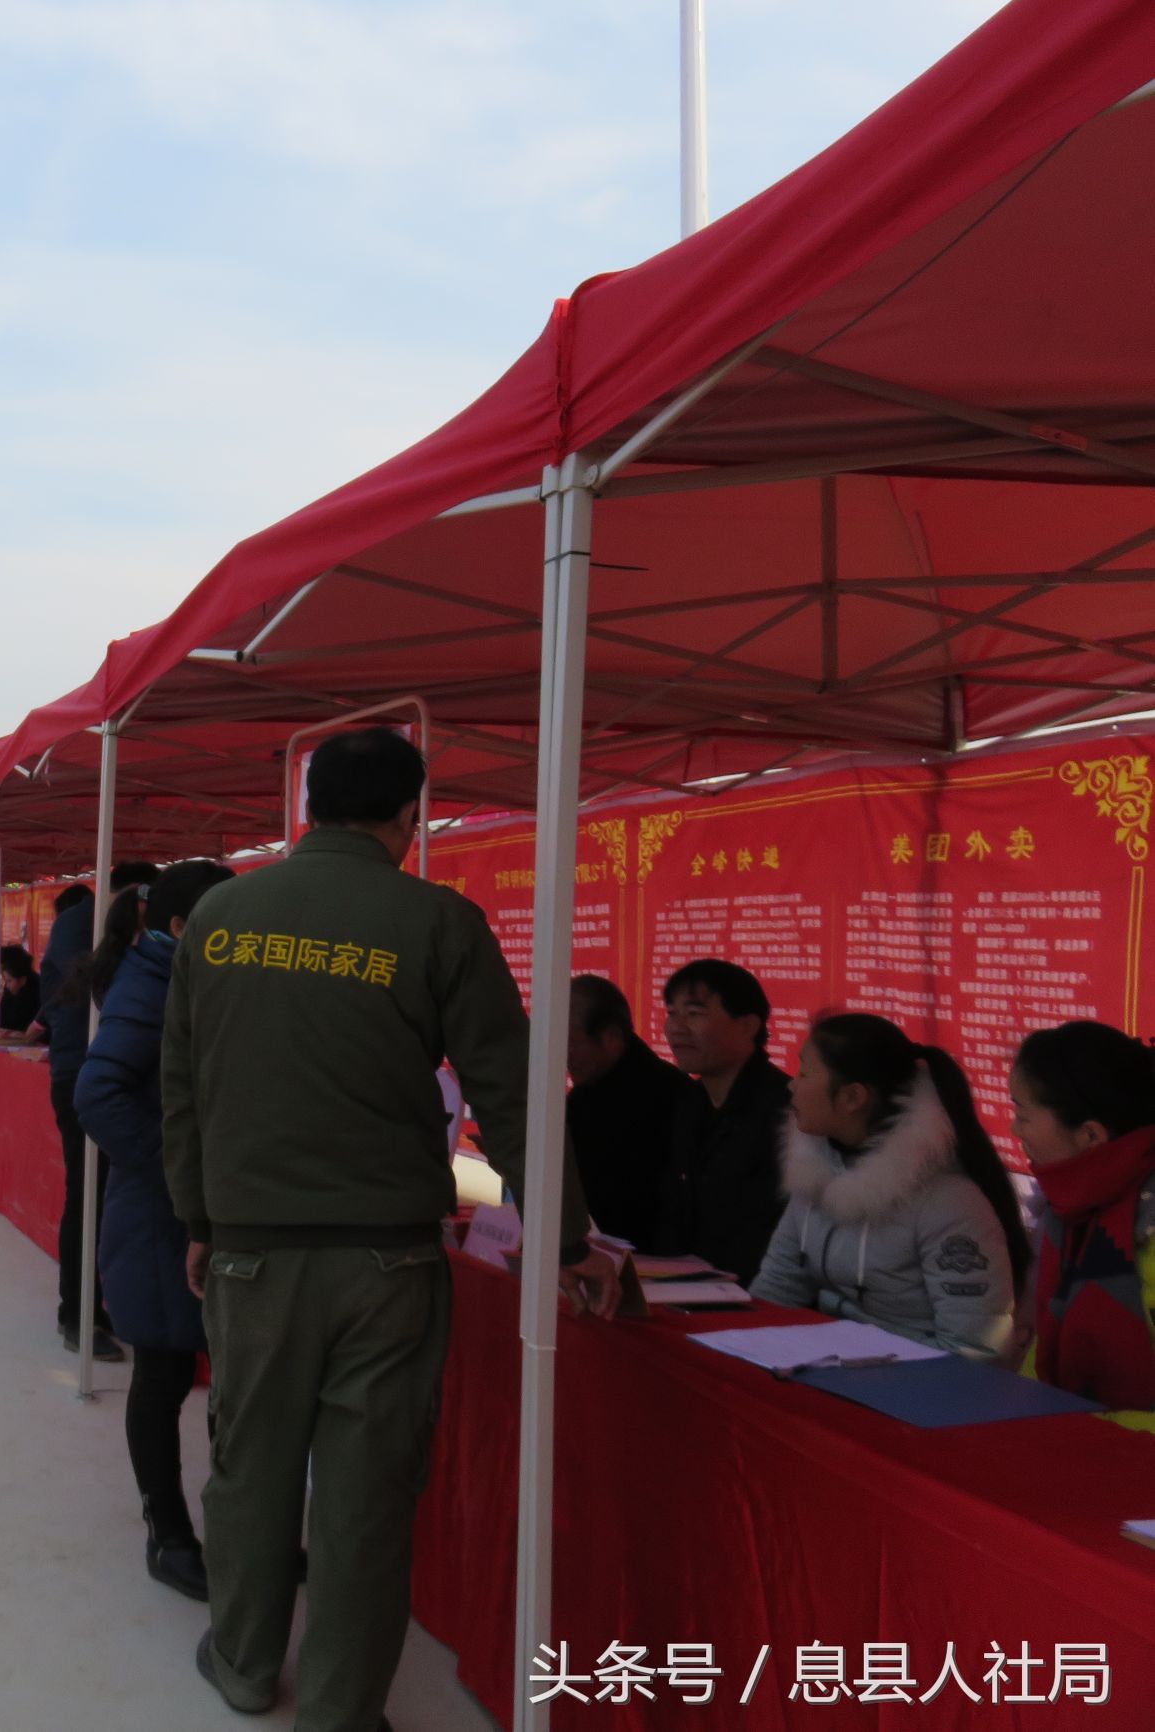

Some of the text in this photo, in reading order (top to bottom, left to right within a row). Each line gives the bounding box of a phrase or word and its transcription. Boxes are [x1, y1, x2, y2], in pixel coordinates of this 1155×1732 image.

[890, 826, 1035, 864] 美团外卖
[204, 928, 398, 987] e家国际家居
